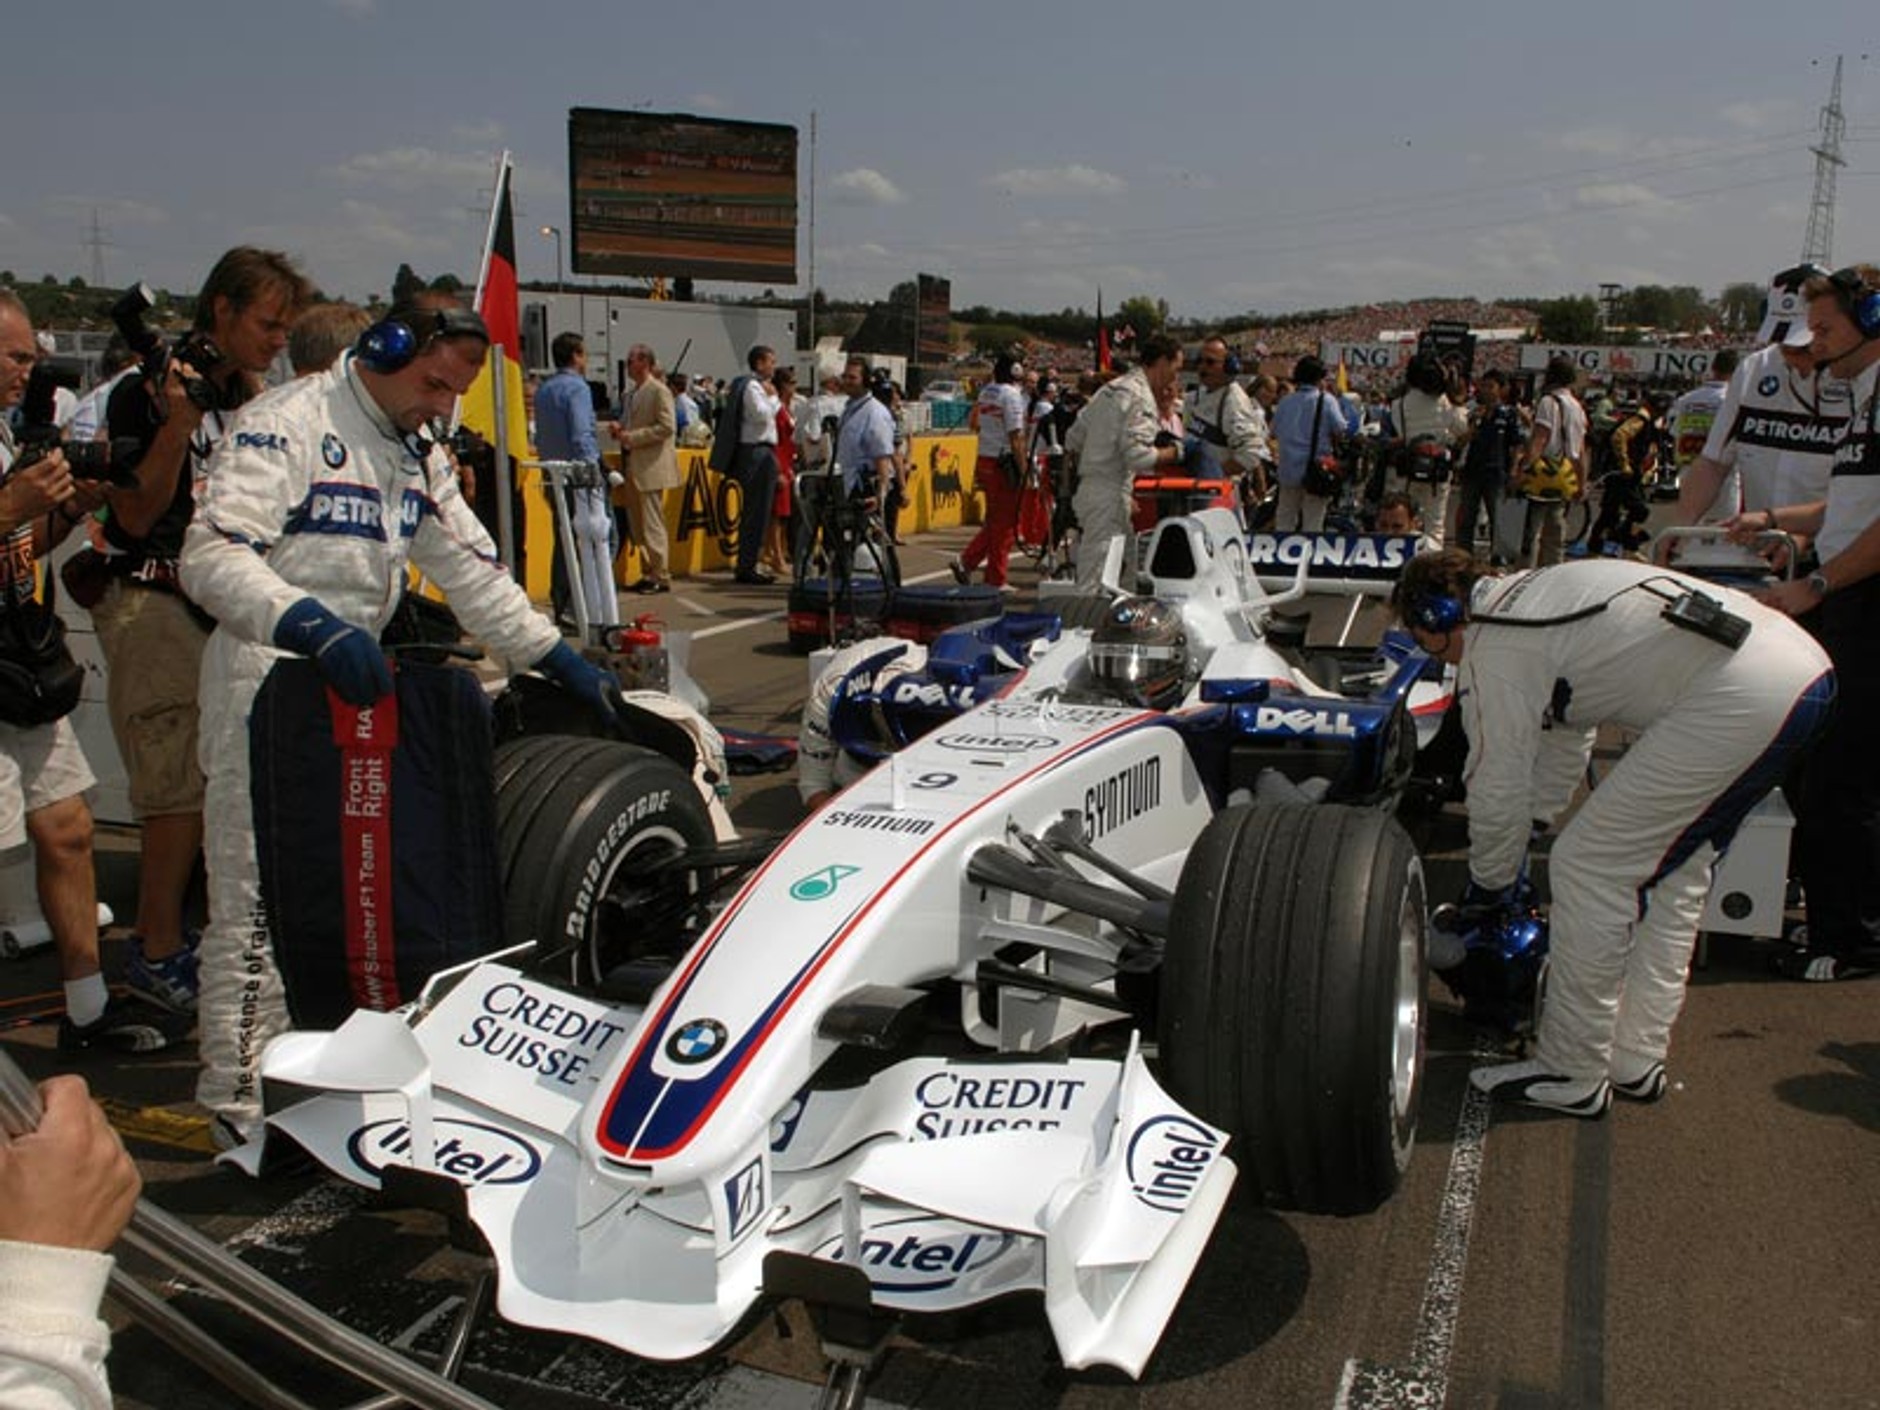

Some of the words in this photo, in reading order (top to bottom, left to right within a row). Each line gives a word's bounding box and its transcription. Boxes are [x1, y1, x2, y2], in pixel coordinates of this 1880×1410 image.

[1350, 347, 1390, 368] NG
[1653, 352, 1710, 375] ING
[677, 455, 745, 557] Ag
[1246, 533, 1406, 568] RONAS
[1256, 706, 1357, 736] DELL
[344, 756, 364, 818] Front
[362, 756, 387, 818] Right
[910, 771, 960, 790] 9
[1084, 754, 1161, 846] SYNTIUM
[822, 810, 936, 836] SYNTIUM
[359, 832, 376, 883] Team
[242, 950, 265, 976] of
[481, 981, 626, 1052] CREDIT
[457, 1014, 590, 1086] SUISSE
[915, 1071, 1086, 1111] CREDIT
[1132, 1132, 1216, 1200] intel
